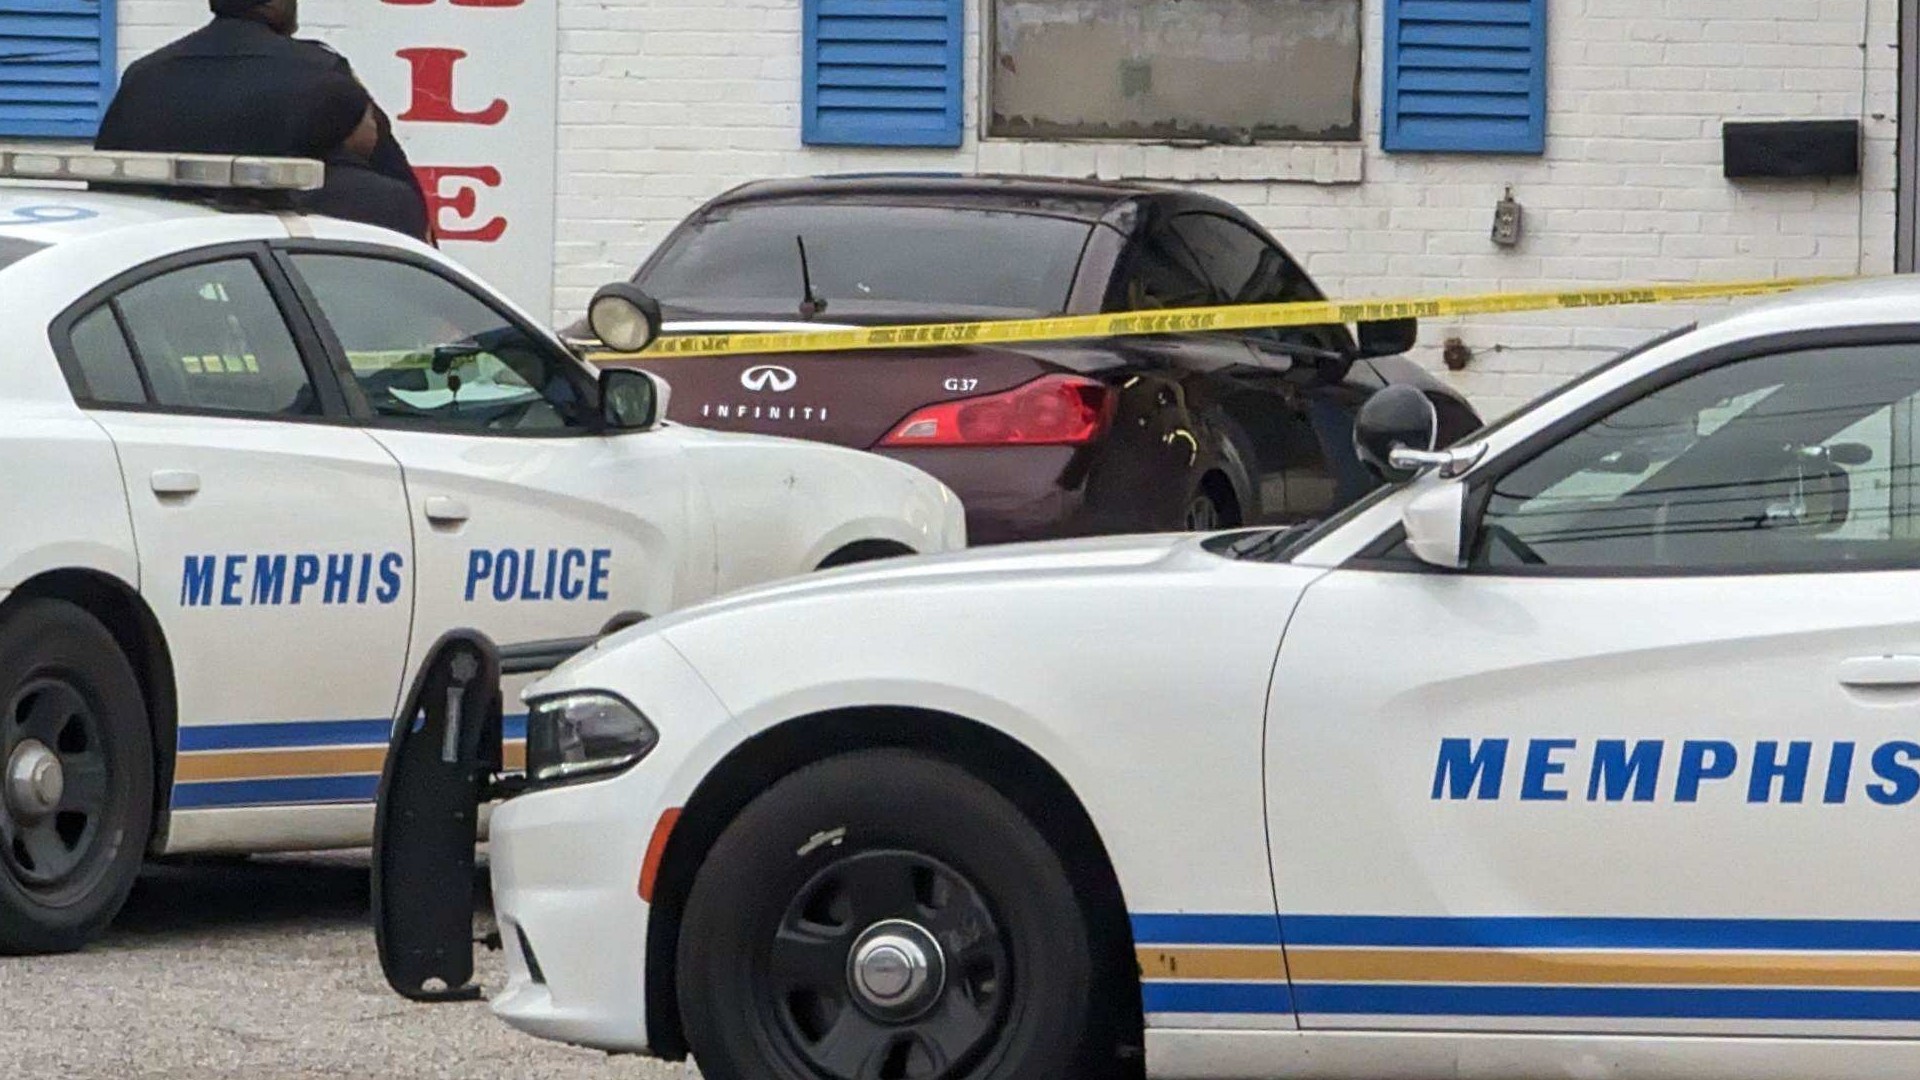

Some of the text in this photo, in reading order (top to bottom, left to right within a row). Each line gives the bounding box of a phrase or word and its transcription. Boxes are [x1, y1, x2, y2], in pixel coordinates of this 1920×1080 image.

[379, 0, 525, 242] LE
[703, 404, 827, 421] INFINITI
[944, 378, 978, 391] G37
[180, 548, 611, 606] MEMPHIS POLICE
[1431, 738, 1920, 806] MEMPHIS
